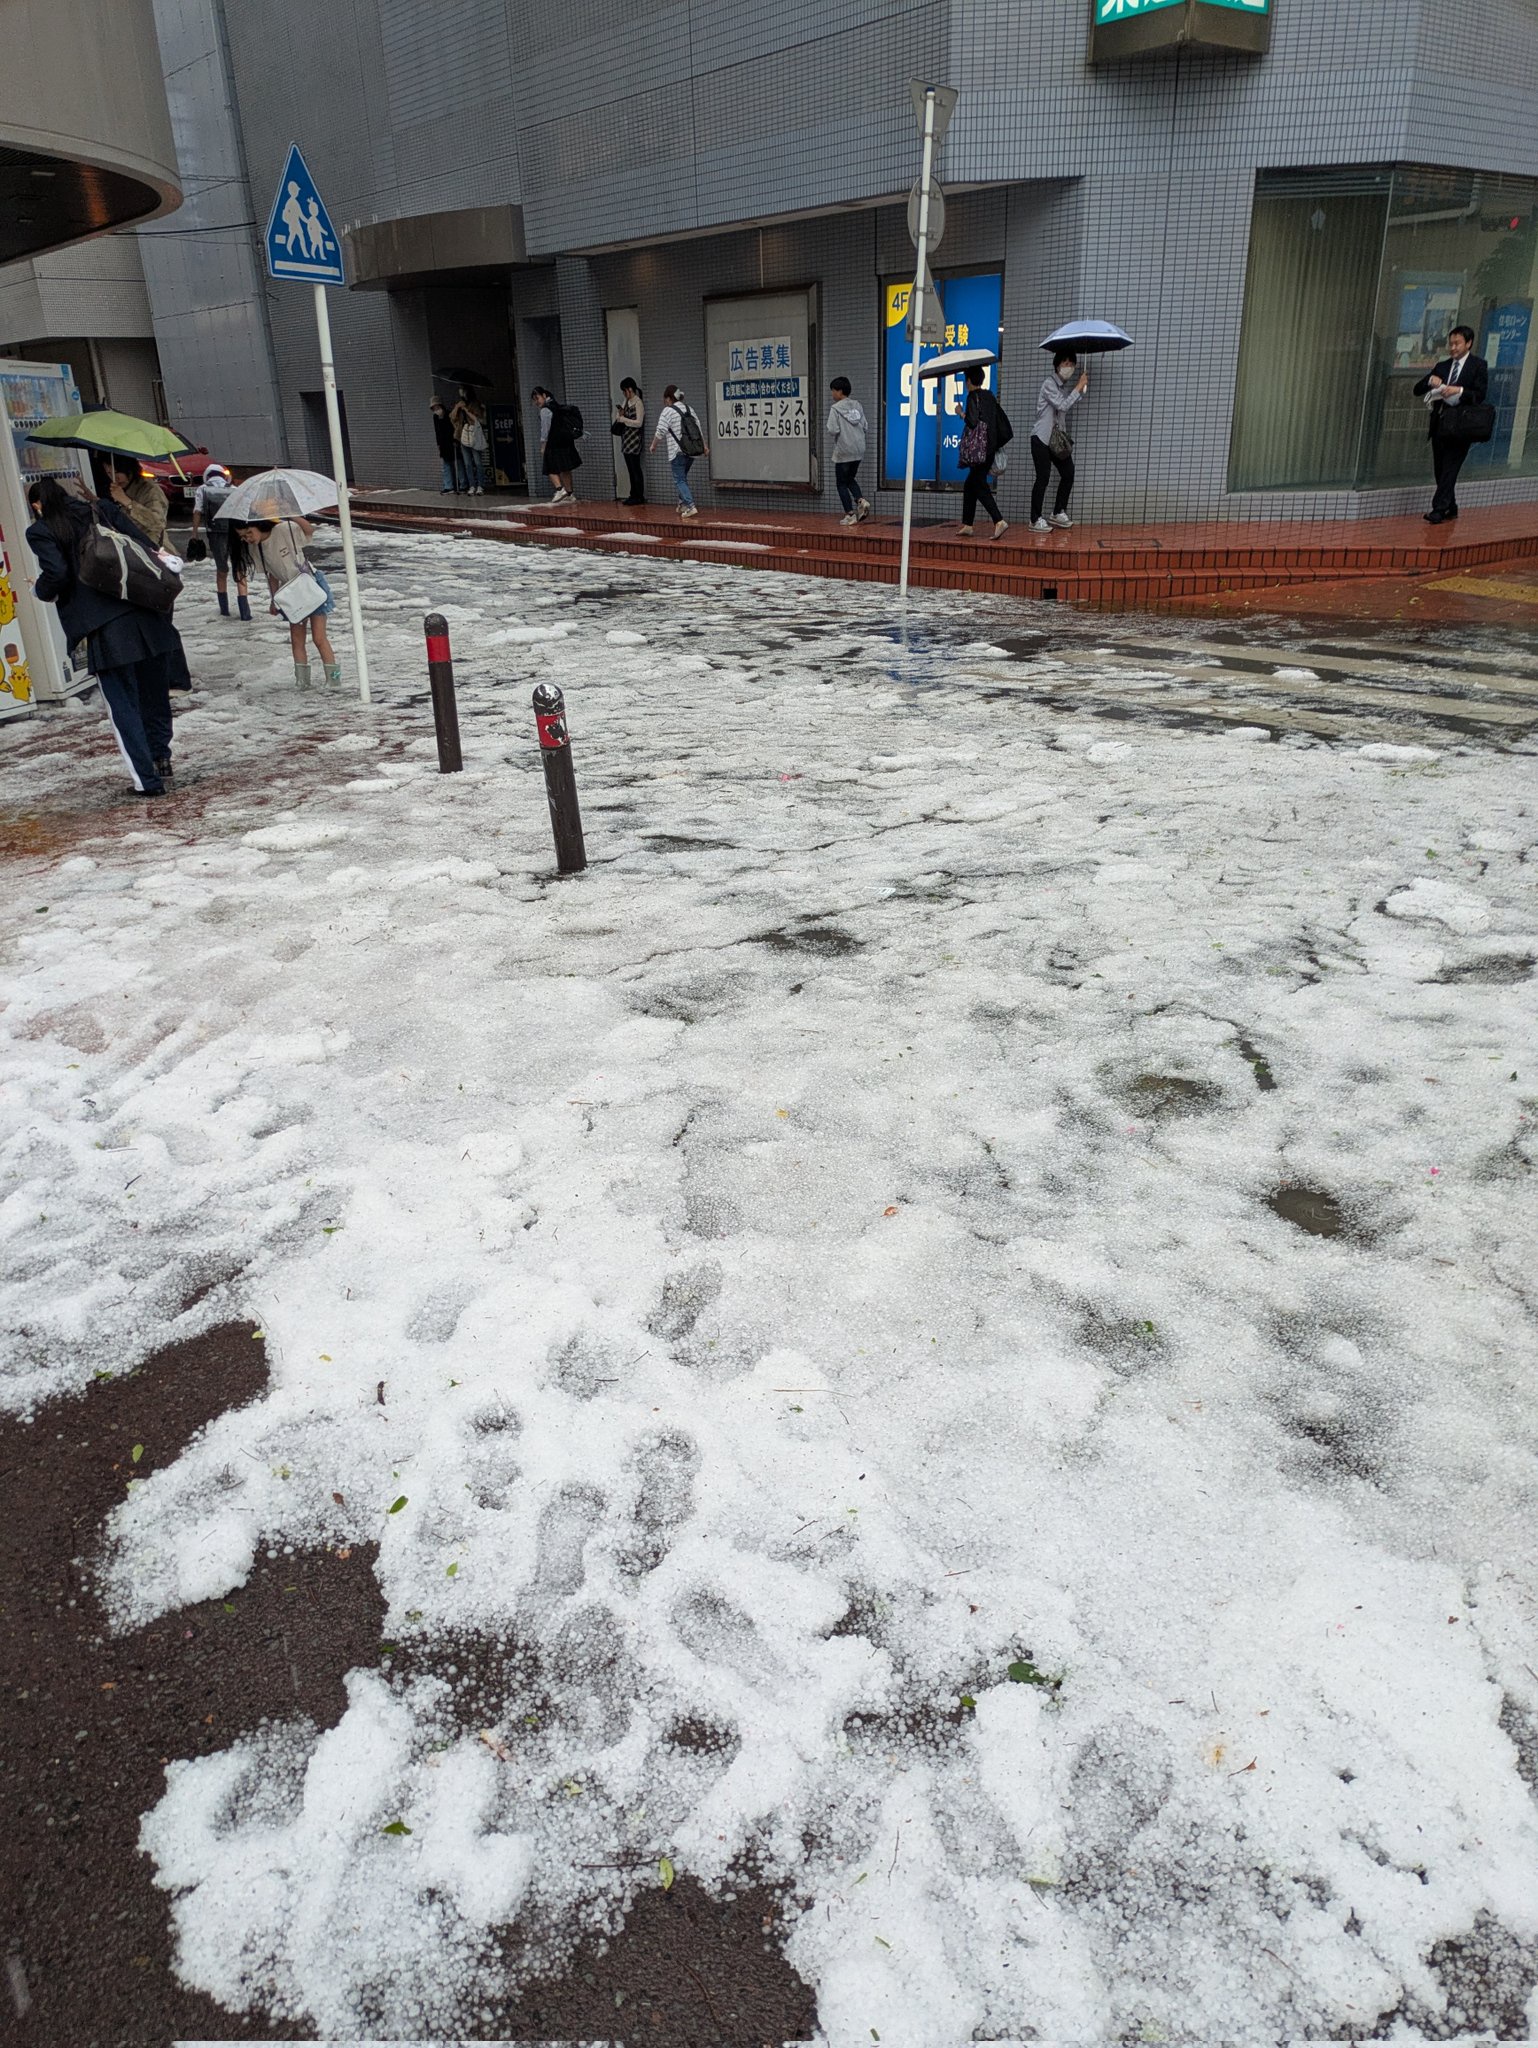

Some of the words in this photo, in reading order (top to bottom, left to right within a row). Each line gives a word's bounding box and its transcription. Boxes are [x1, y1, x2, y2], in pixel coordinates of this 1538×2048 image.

[891, 291, 909, 311] 4F
[730, 343, 790, 372] 広告募集
[718, 418, 807, 437] 045-572-5961
